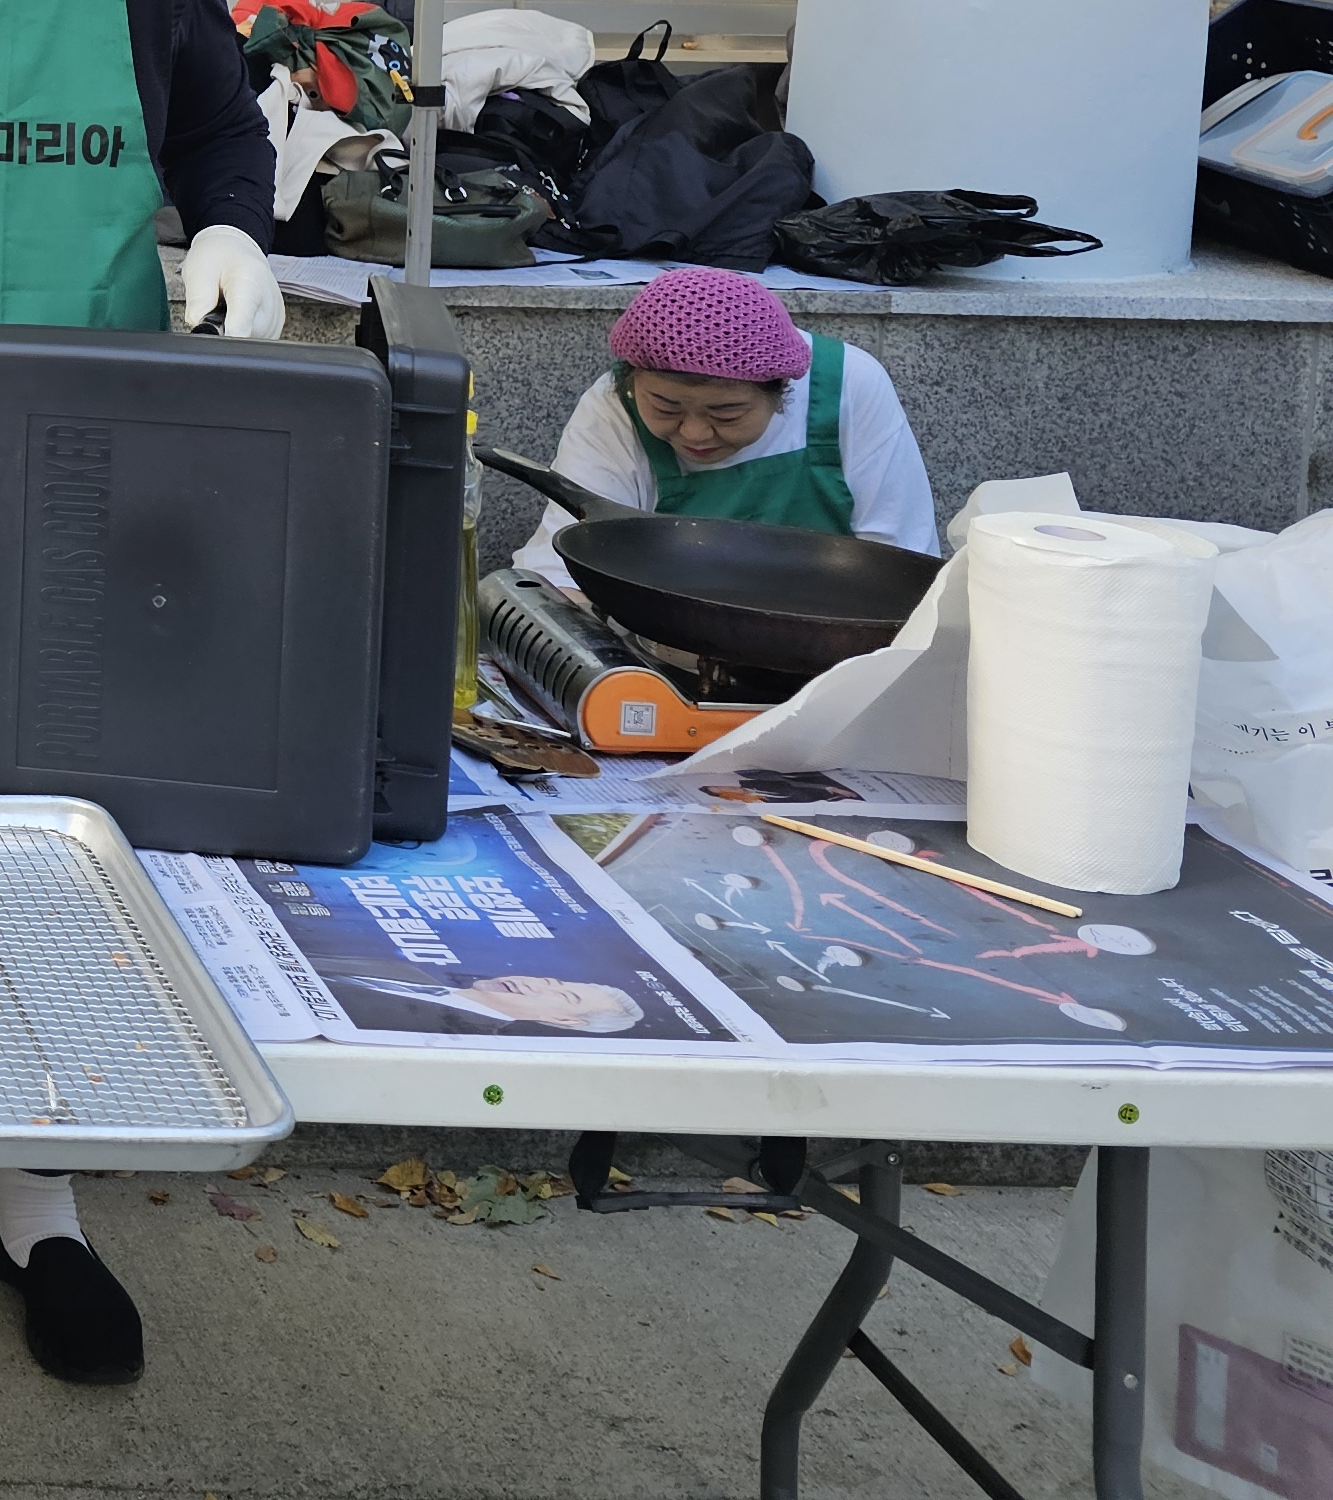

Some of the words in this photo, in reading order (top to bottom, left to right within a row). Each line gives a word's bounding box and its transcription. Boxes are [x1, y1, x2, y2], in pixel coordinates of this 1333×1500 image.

[42, 424, 111, 540] COOKER
[40, 547, 106, 603] GAS
[339, 875, 462, 966] 보내드립니다
[401, 875, 483, 921] 무료로
[457, 875, 556, 939] 보청기를
